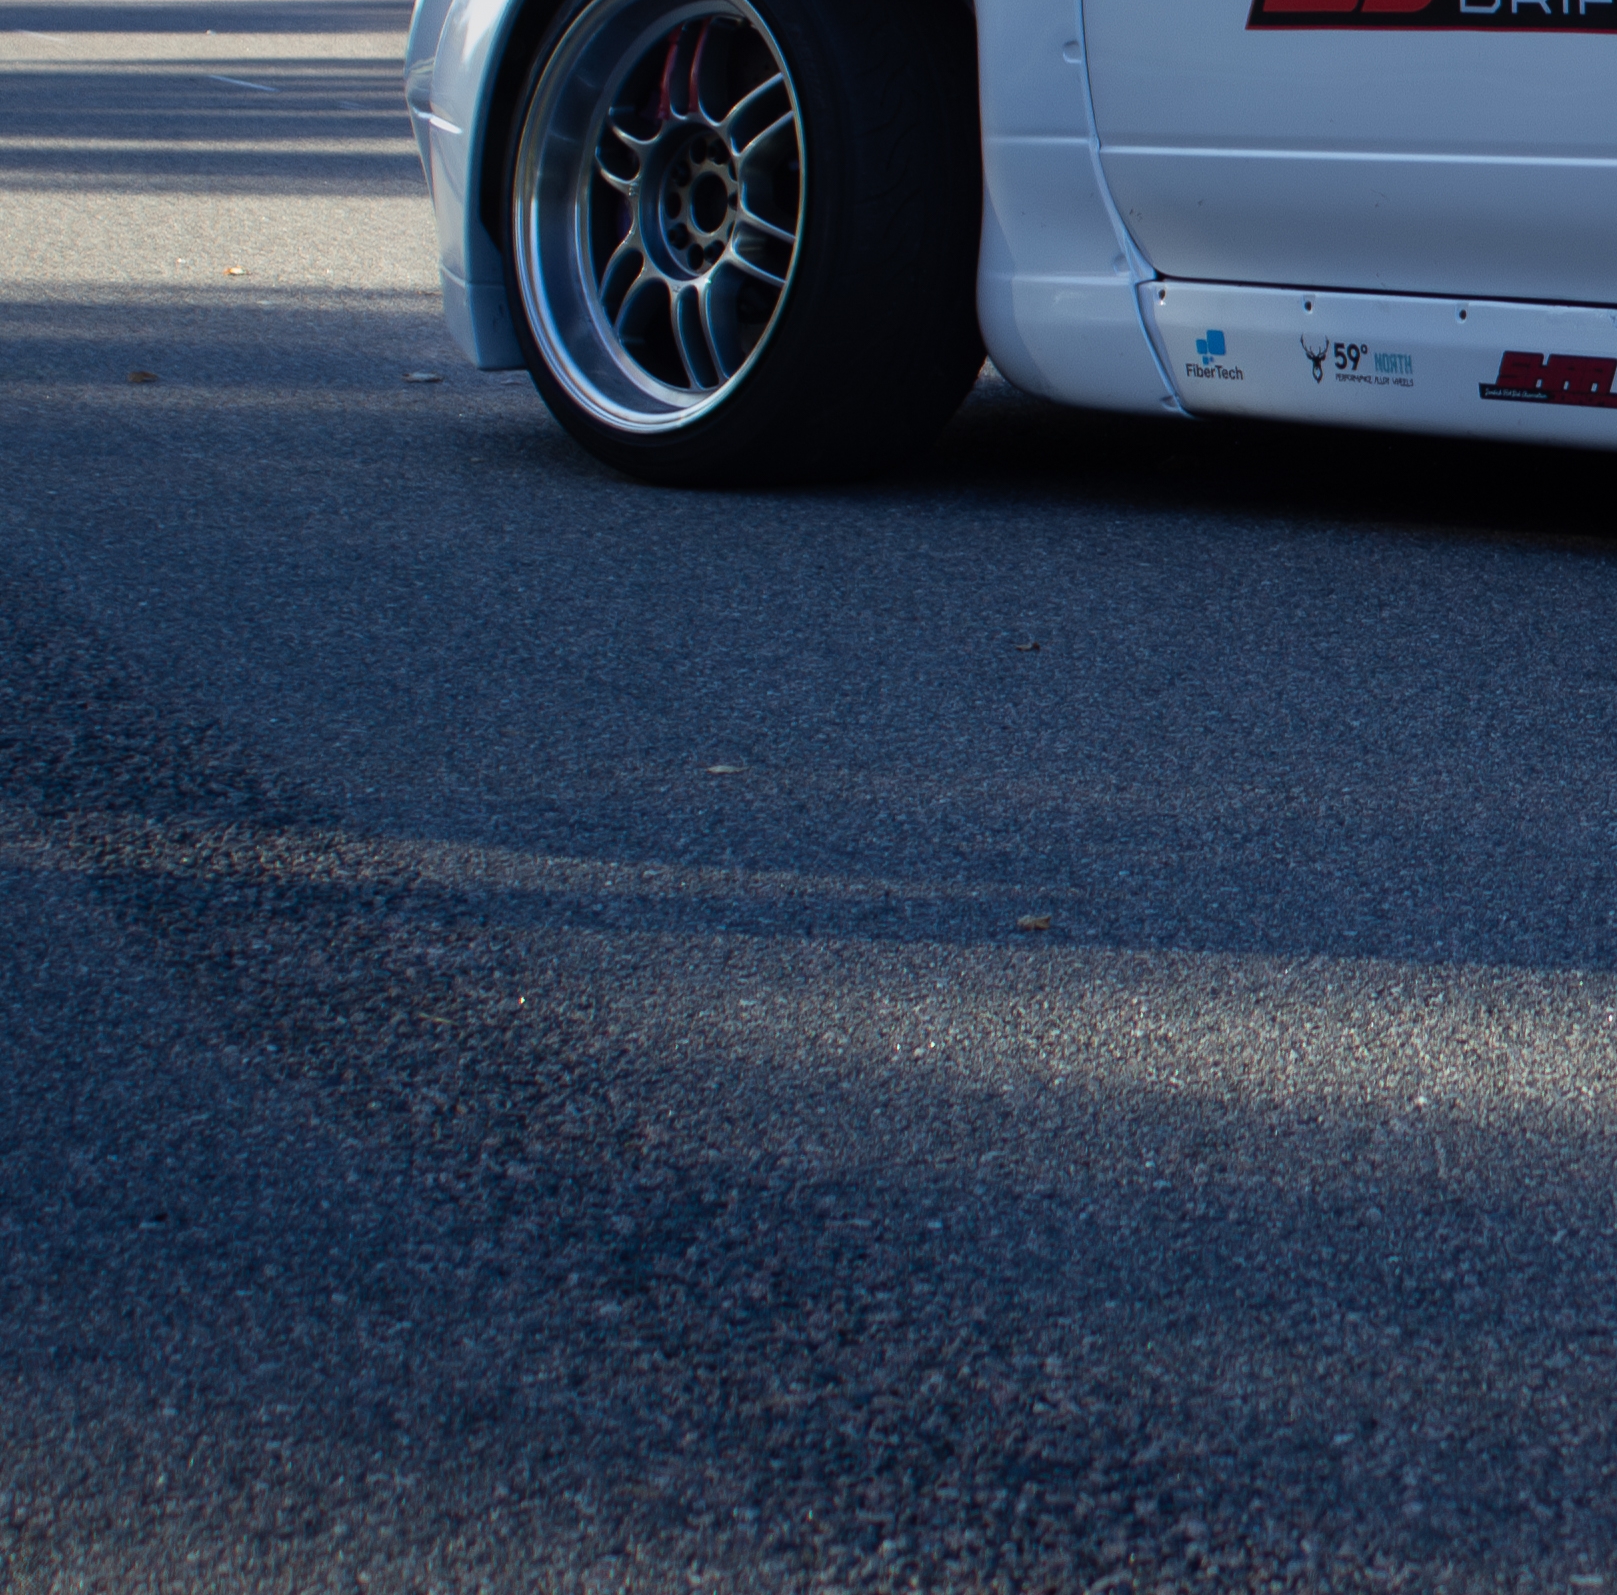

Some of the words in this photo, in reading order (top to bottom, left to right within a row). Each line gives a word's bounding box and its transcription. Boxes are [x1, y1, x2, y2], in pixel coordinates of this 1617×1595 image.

[1333, 341, 1369, 371] 59°
[1374, 352, 1414, 375] NORTH
[1185, 362, 1244, 381] FiberTech
